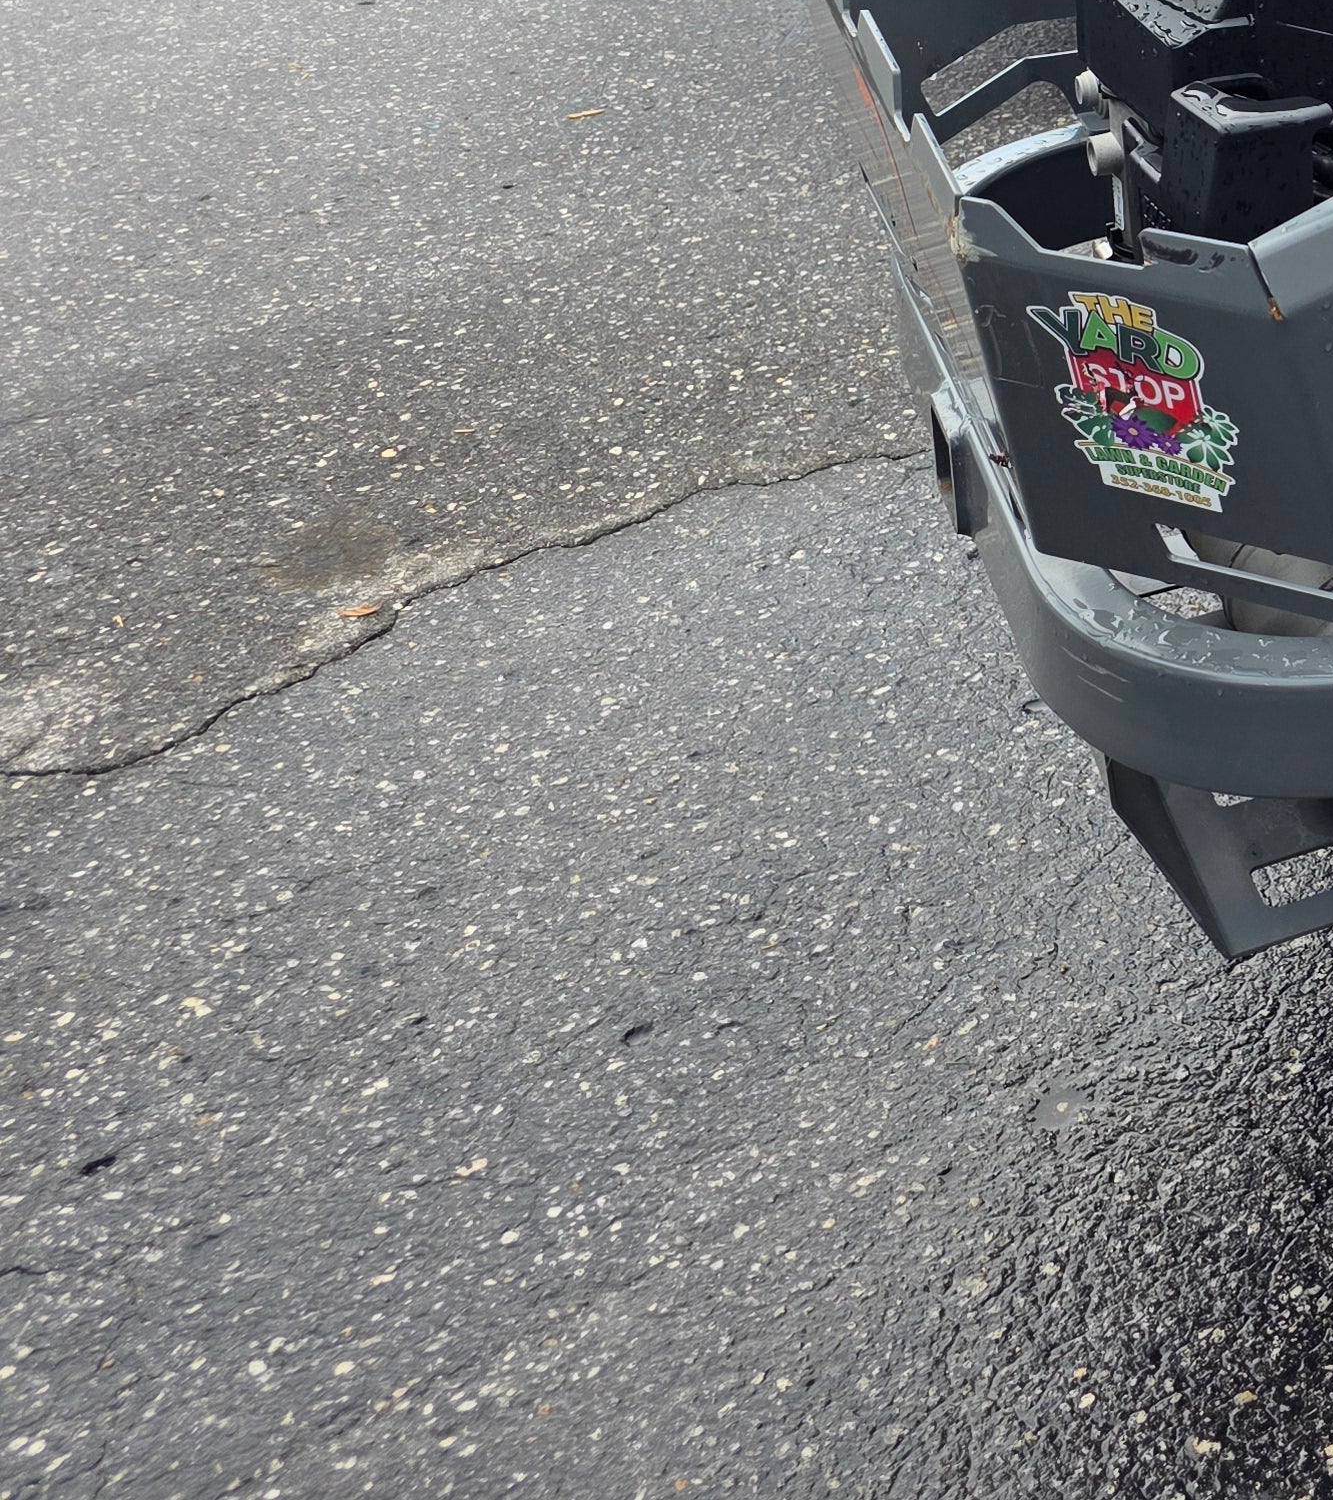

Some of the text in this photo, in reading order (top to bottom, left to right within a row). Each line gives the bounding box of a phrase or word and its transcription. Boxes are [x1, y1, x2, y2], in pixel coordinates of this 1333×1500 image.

[1073, 294, 1154, 332] THE
[1029, 308, 1201, 379] YARD
[1081, 362, 1186, 409] STOP
[1085, 446, 1227, 494] LAWN & GARDEN
[1115, 463, 1202, 494] SUPERSTORE
